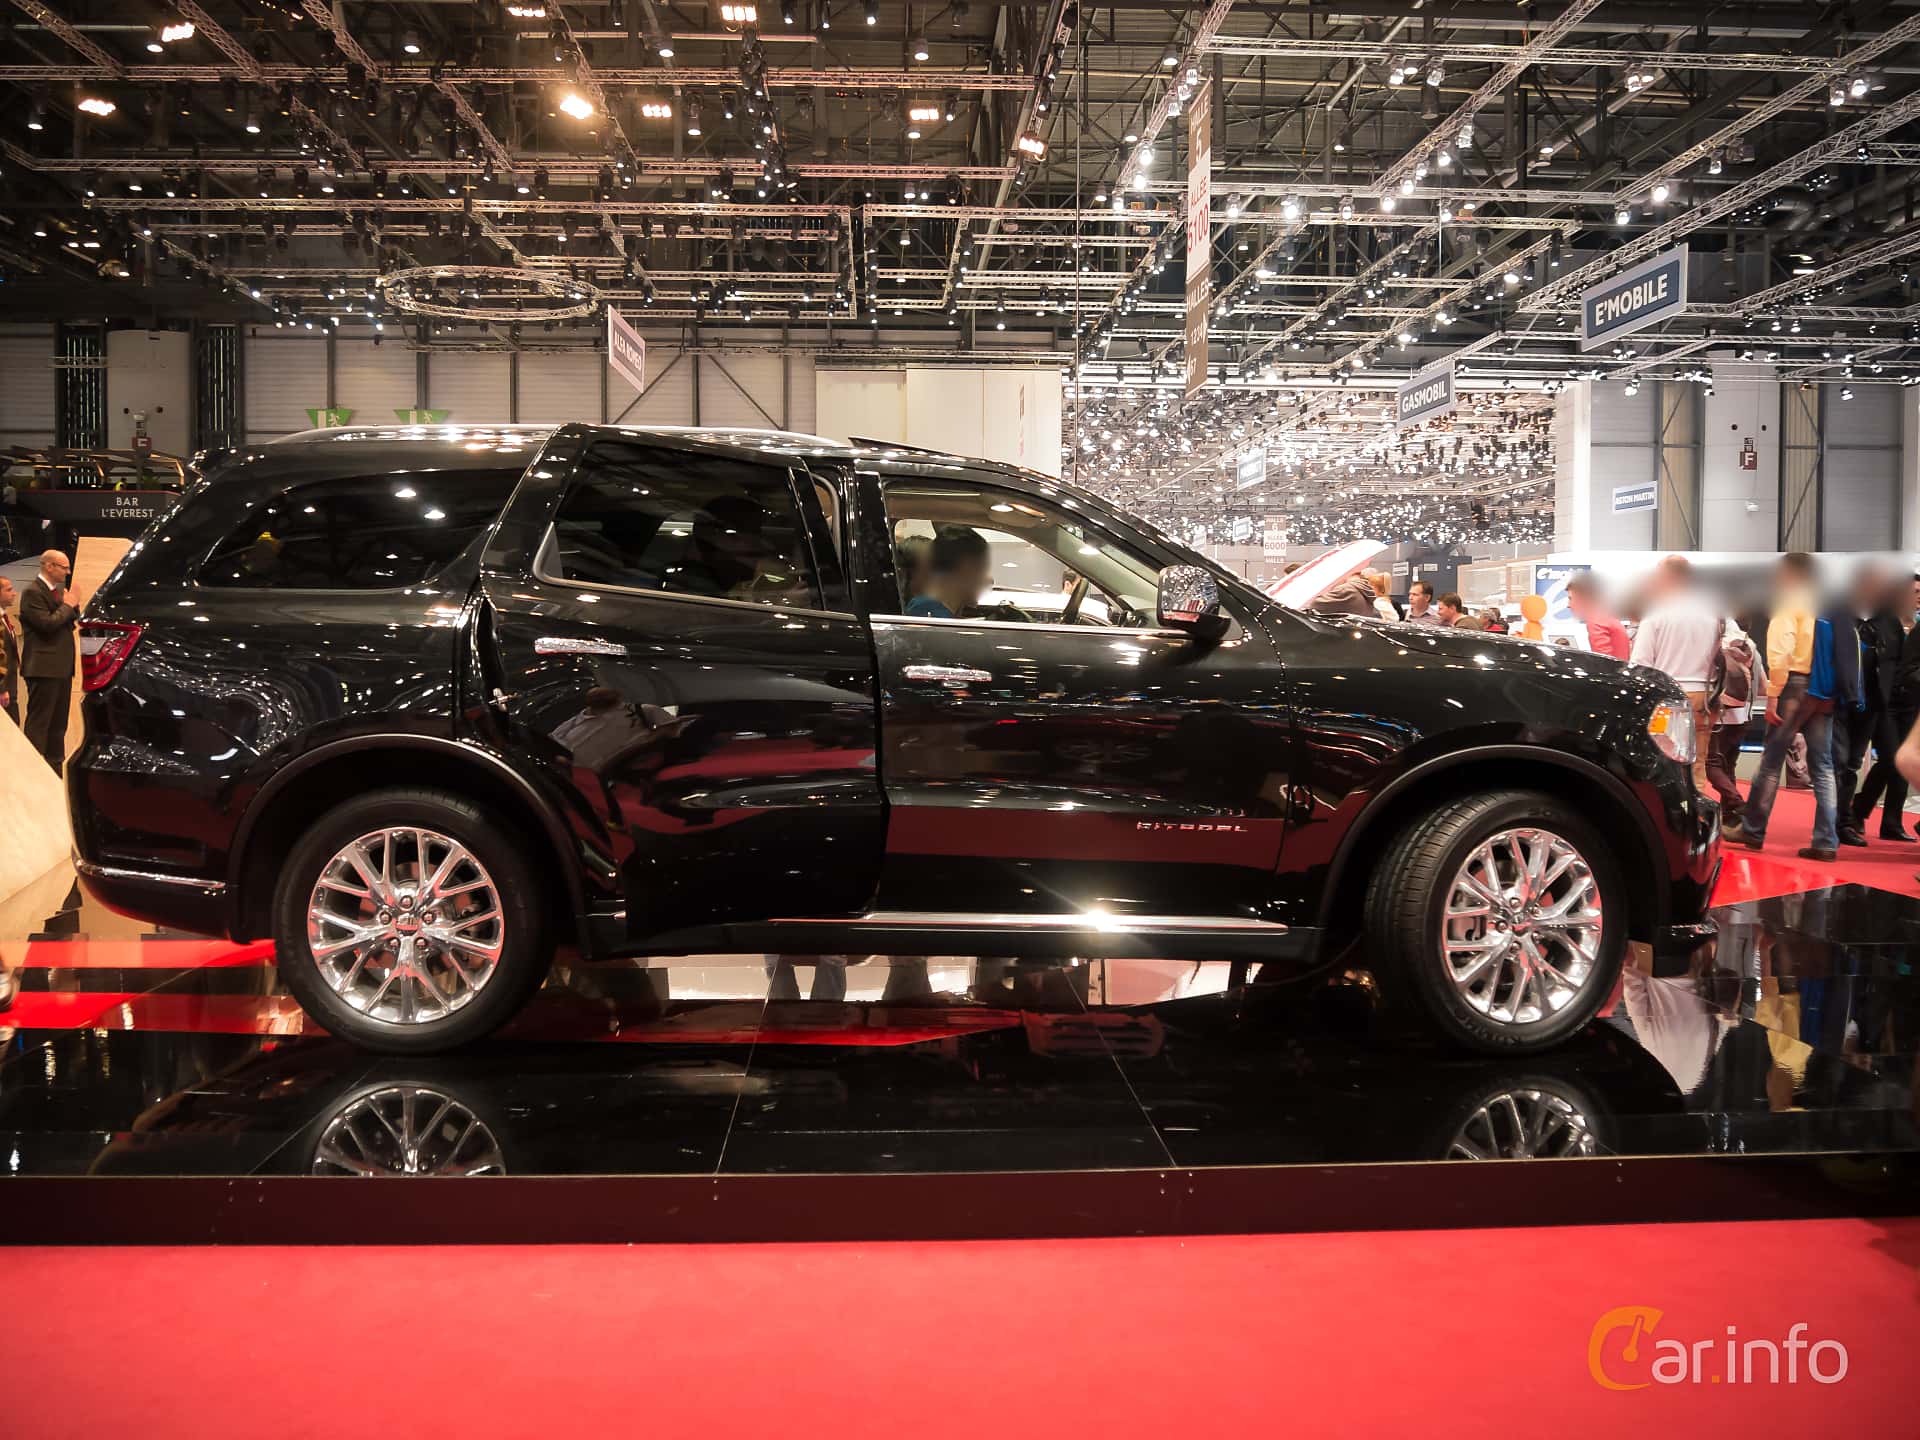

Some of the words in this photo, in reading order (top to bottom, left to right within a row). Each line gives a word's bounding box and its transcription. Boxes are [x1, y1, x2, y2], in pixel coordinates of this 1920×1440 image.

[1188, 203, 1208, 253] 5100
[1595, 273, 1668, 327] E'MOBILE
[1402, 380, 1447, 413] GASMOBIL
[101, 508, 154, 518] L'EVEREST
[116, 496, 139, 506] BAR
